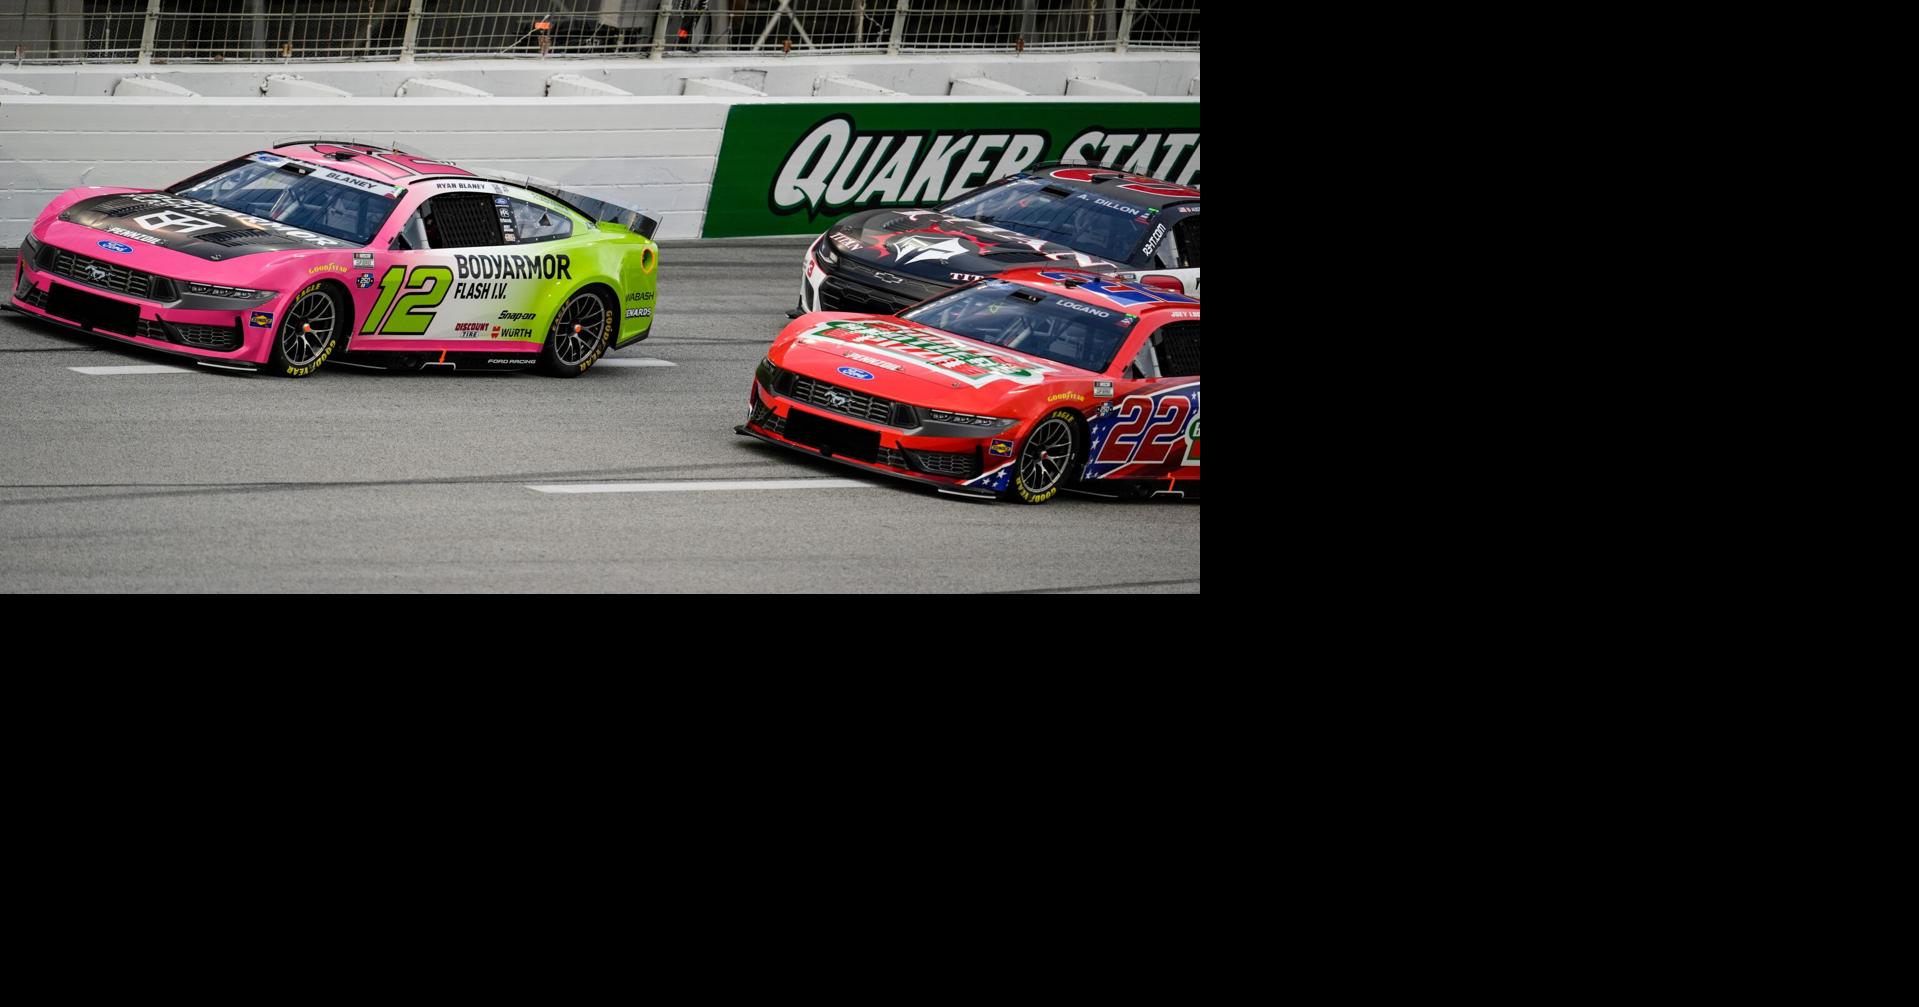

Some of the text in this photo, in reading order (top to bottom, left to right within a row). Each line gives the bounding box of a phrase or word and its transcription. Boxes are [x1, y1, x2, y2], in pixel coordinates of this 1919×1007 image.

[774, 118, 1045, 208] QUAKER
[326, 172, 377, 190] BLANEY
[1094, 199, 1140, 216] DILLON
[308, 262, 349, 274] GOODYEAR
[454, 253, 572, 280] BODYARMOR
[294, 282, 321, 302] EAGLE
[454, 282, 491, 299] FLASH
[359, 265, 454, 336] 12
[1056, 299, 1110, 318] LOGANO
[498, 310, 536, 320] Snap-on
[454, 322, 489, 331] DISCOUNT
[287, 340, 336, 376] GOODYEAR
[1048, 391, 1085, 402] GOODYEAR
[1052, 411, 1075, 423] EAGLE
[1095, 395, 1191, 464] 22
